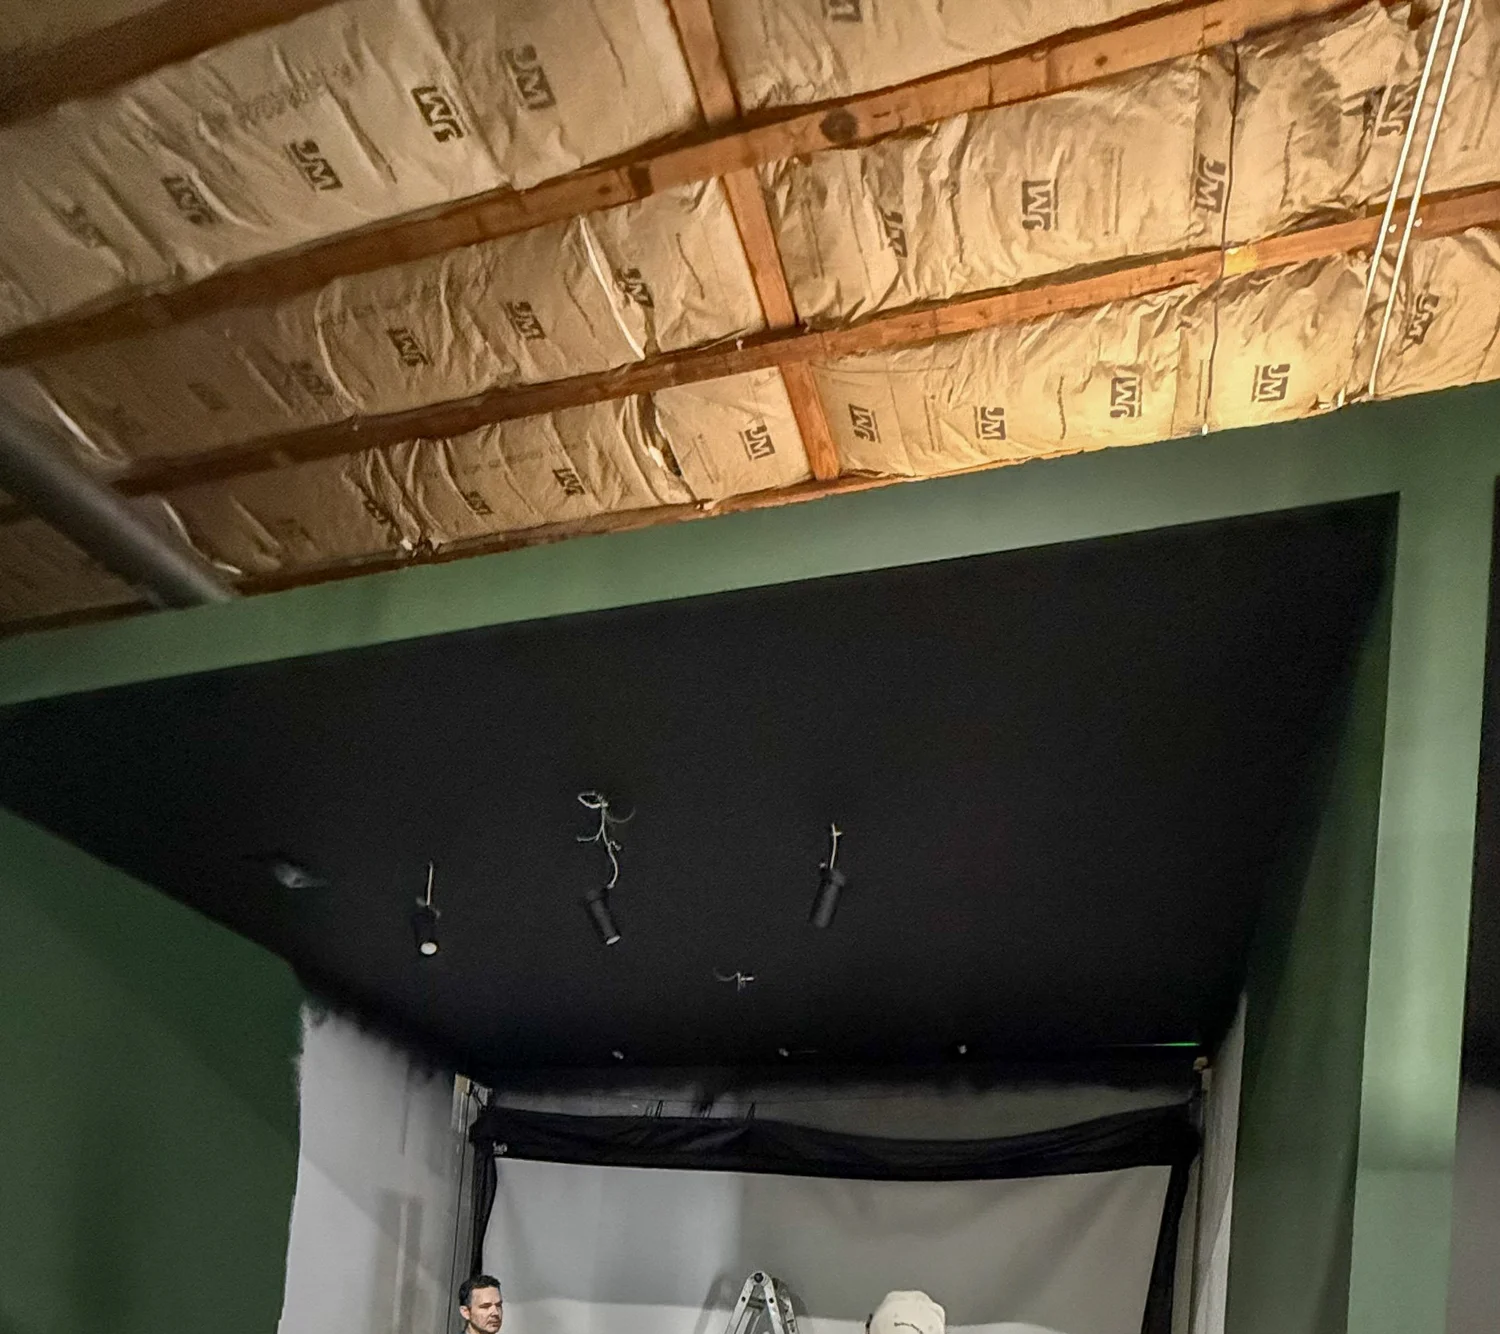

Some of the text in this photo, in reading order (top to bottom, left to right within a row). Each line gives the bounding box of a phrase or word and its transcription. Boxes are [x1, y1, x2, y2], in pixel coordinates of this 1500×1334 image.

[411, 86, 464, 142] JM
[290, 139, 343, 190] JM
[1195, 156, 1227, 213] JM
[1022, 180, 1051, 231] JM
[512, 302, 546, 339] JM
[1110, 377, 1137, 418] JM
[1258, 363, 1290, 402] JM
[744, 425, 775, 459] JM
[848, 403, 875, 442] JM
[981, 407, 1006, 440] JM
